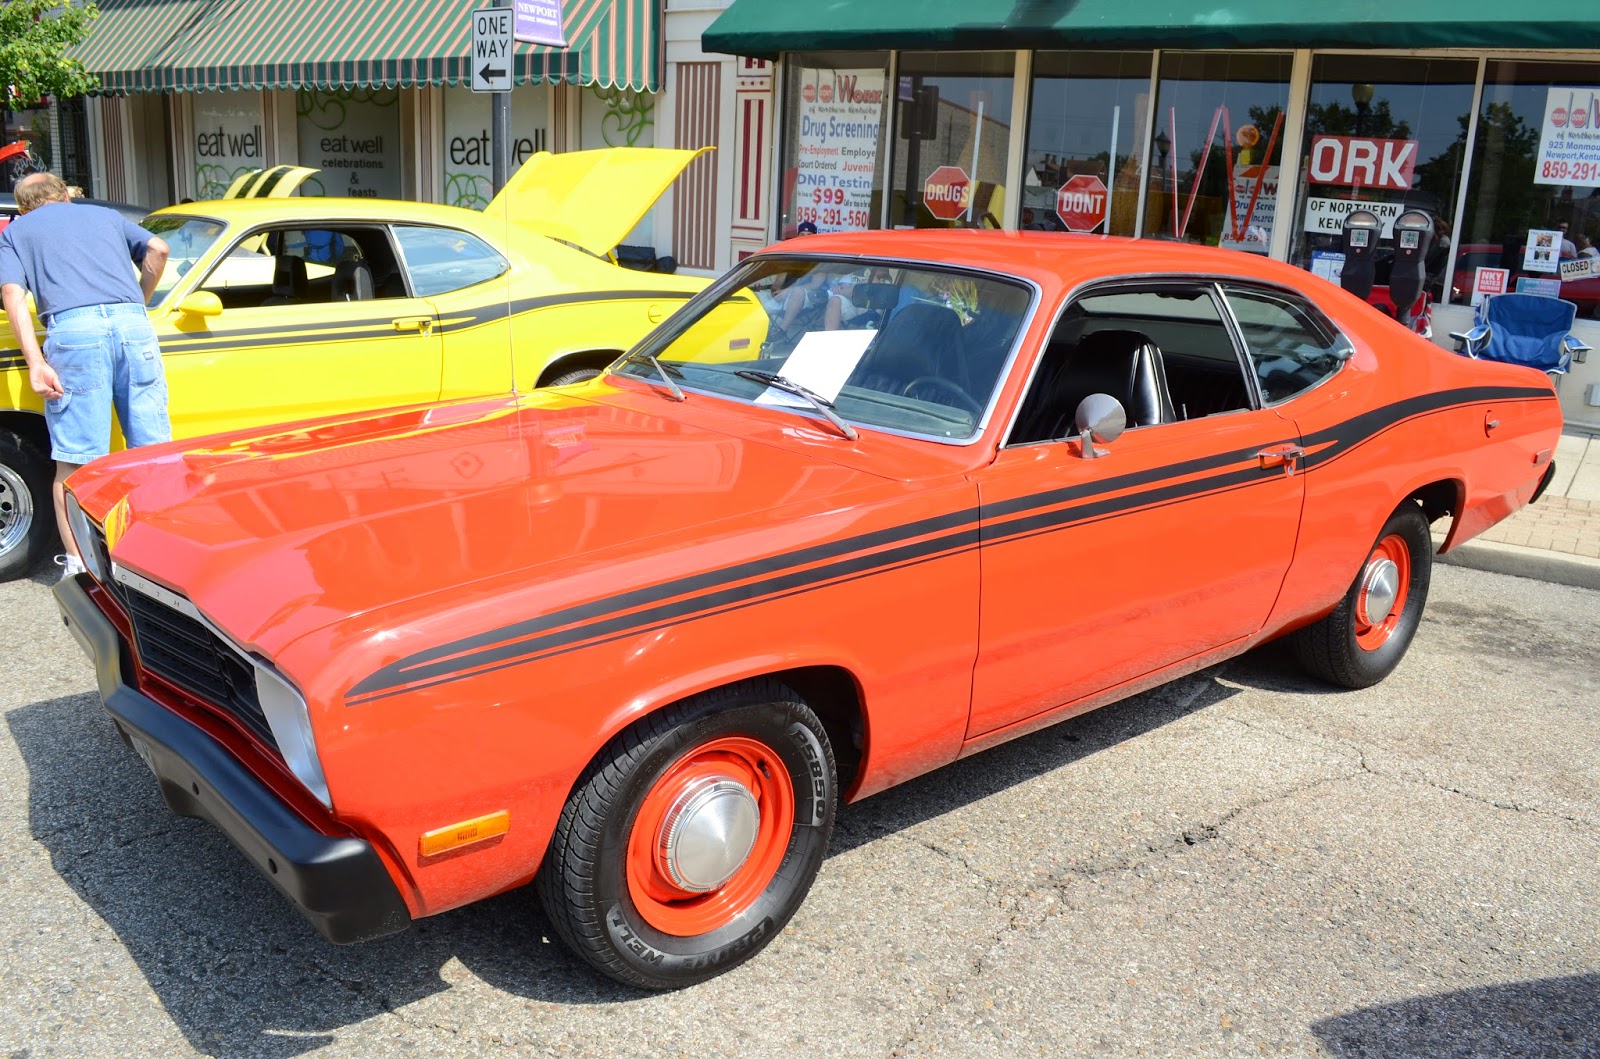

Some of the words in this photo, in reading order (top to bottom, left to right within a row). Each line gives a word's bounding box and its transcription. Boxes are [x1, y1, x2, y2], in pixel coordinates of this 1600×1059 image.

[518, 2, 557, 18] NEWPORT
[478, 16, 507, 35] ONE
[476, 39, 508, 58] WAY
[802, 115, 826, 144] Drug
[829, 115, 879, 146] Screening
[197, 126, 226, 157] eat
[227, 125, 263, 158] well
[320, 136, 348, 153] eat
[350, 136, 383, 154] well
[450, 129, 490, 166] eat
[1548, 141, 1563, 149] 925
[322, 158, 384, 168] celebrations
[815, 160, 837, 170] Ordered
[1311, 138, 1415, 187] ORK
[350, 172, 360, 184] &
[798, 173, 826, 186] DNA
[348, 187, 378, 197] feasts
[813, 186, 844, 206] $99
[926, 184, 969, 203] DRUGS
[1062, 193, 1104, 214] DONT
[1311, 200, 1326, 212] OF
[1481, 271, 1503, 280] NKY
[1562, 261, 1589, 273] CLOSED
